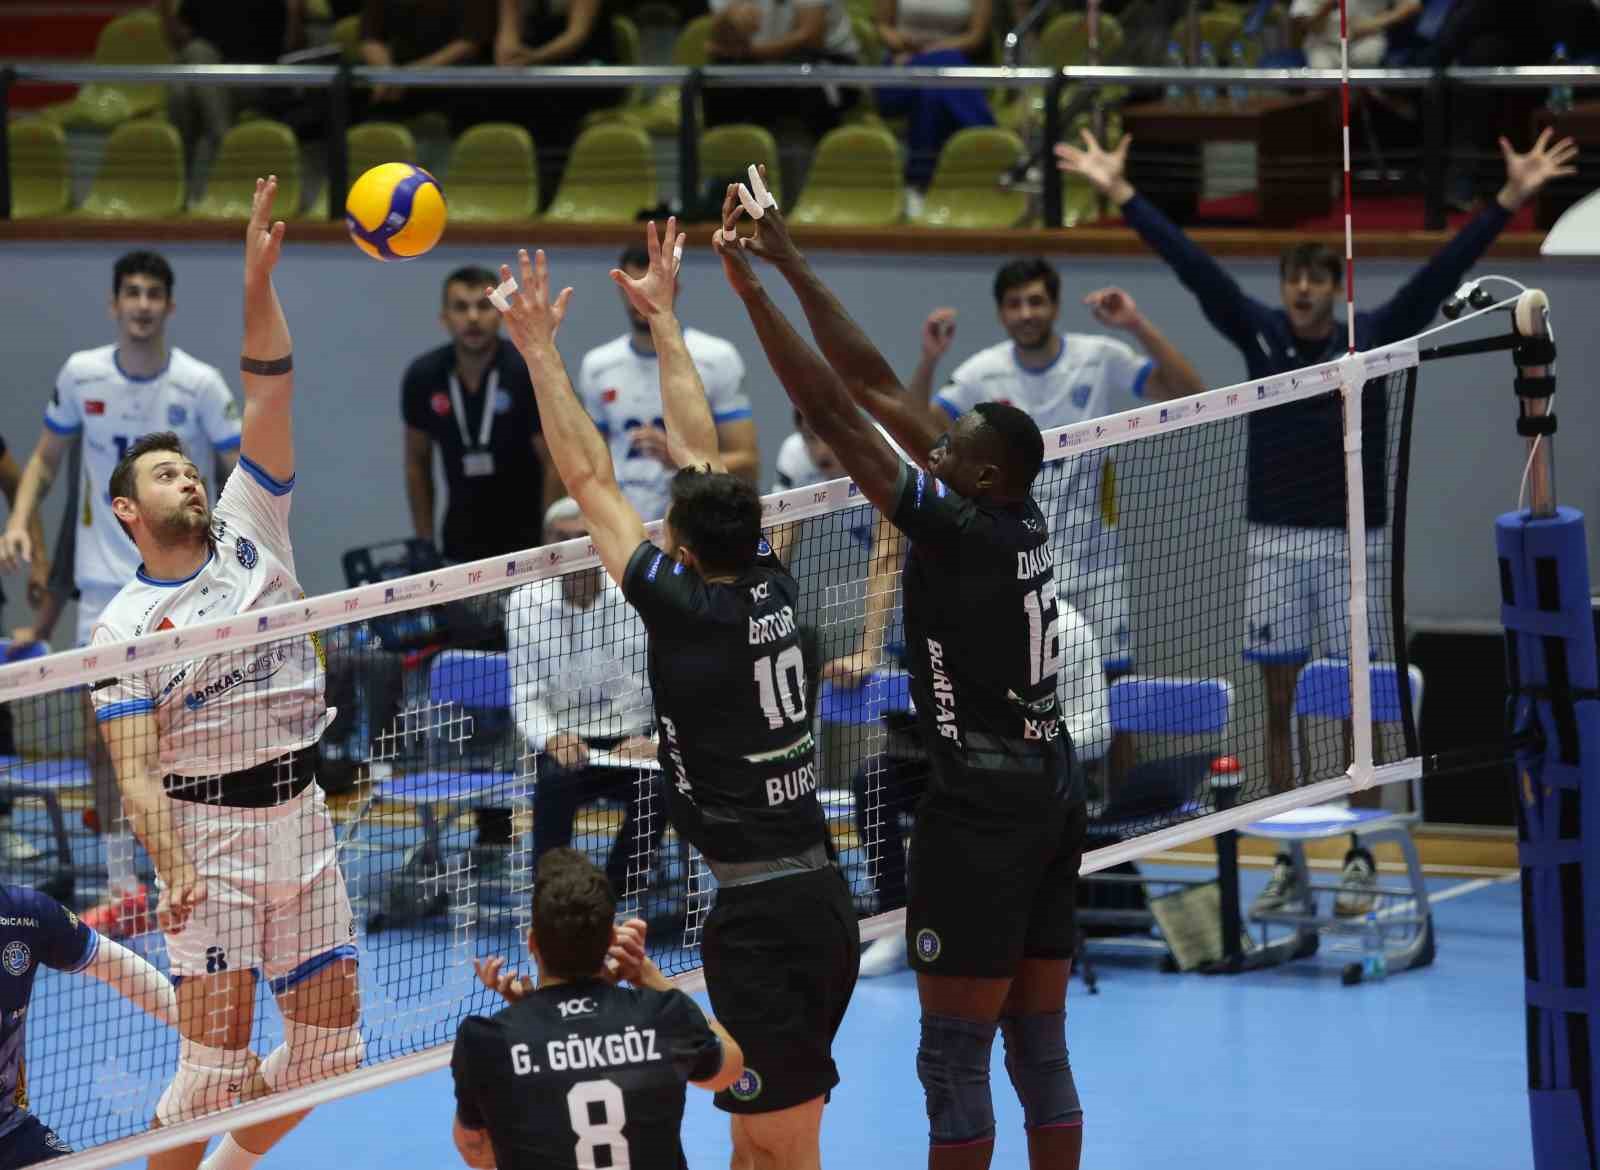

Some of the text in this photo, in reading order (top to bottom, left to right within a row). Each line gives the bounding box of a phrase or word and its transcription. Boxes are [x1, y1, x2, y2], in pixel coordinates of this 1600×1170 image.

[468, 571, 483, 585] TVF
[749, 605, 796, 645] BATUR
[753, 645, 807, 730] 10
[510, 1026, 661, 1076] G. GÖKGÖZ
[567, 1079, 632, 1170] 8
